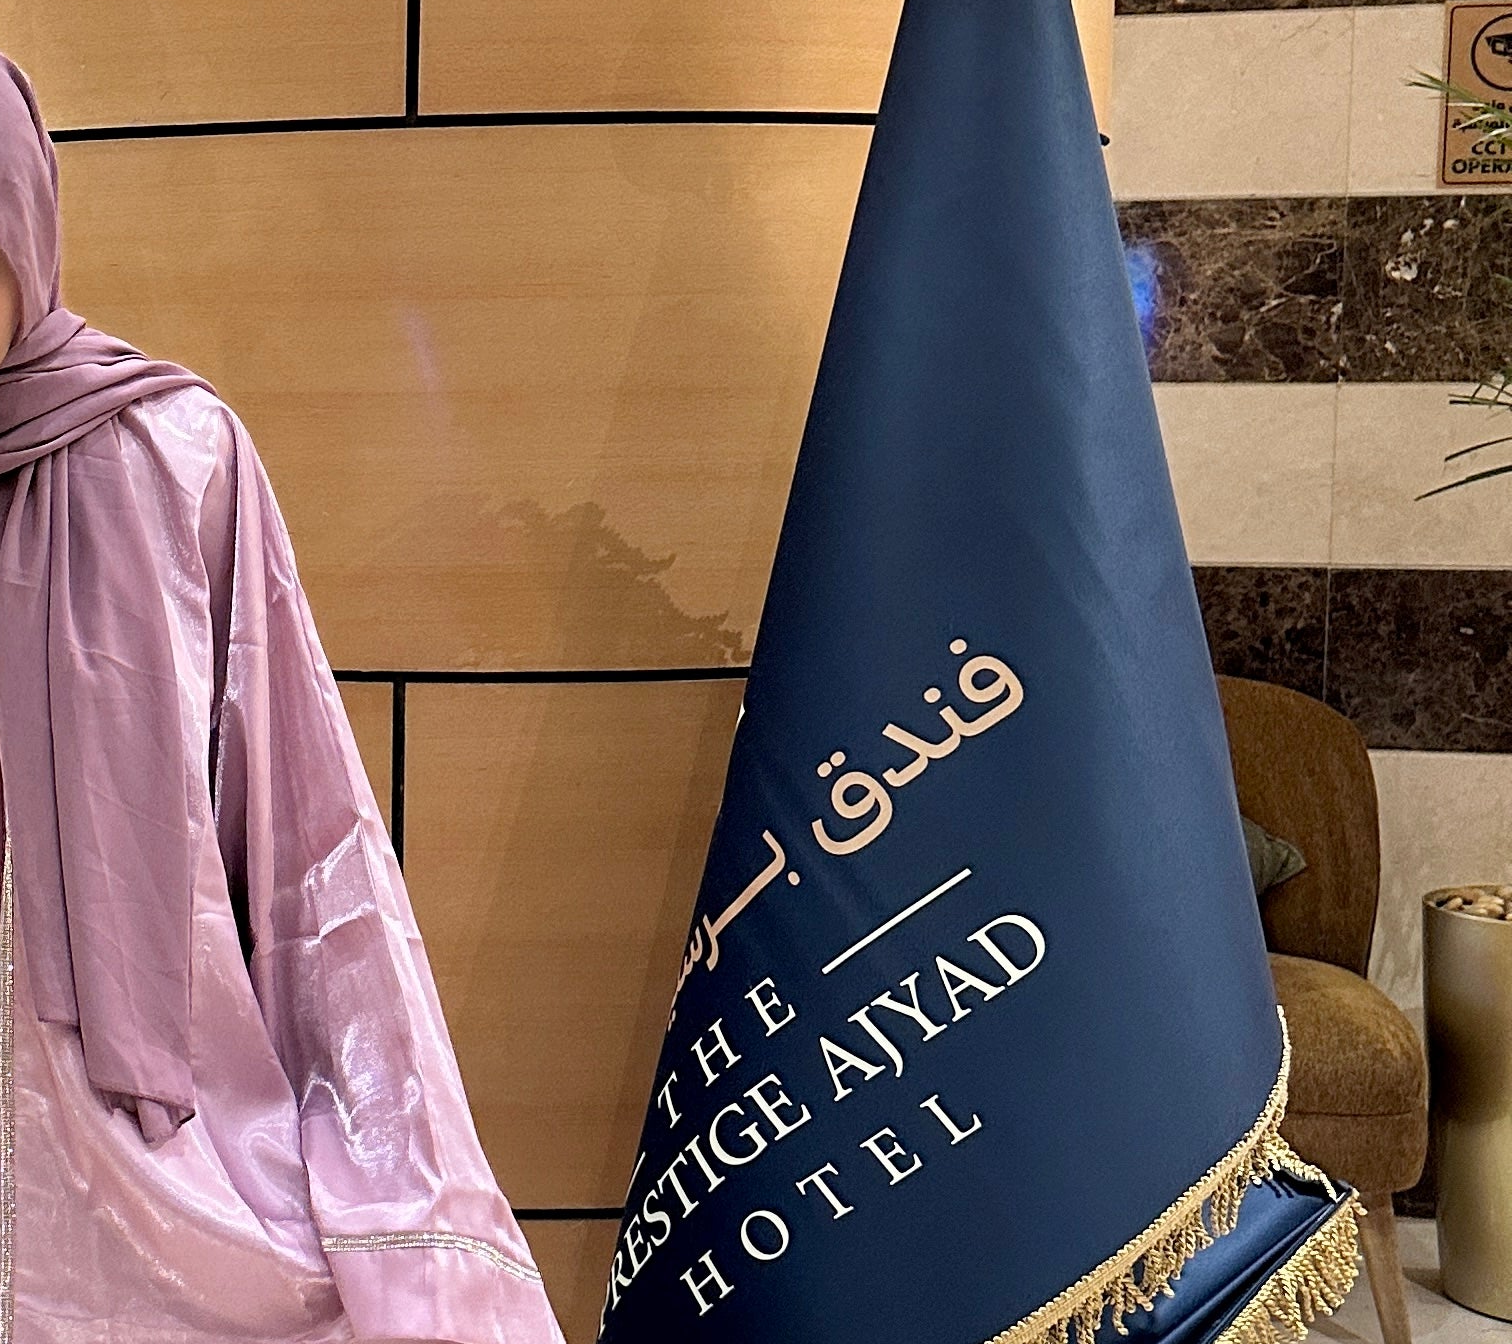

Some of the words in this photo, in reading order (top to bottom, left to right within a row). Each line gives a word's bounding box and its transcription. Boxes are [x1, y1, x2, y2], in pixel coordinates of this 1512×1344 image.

[811, 638, 1025, 855] فندق
[657, 977, 796, 1129] THE
[819, 914, 1047, 1102] AJYAD
[679, 1094, 982, 1317] HOTEL
